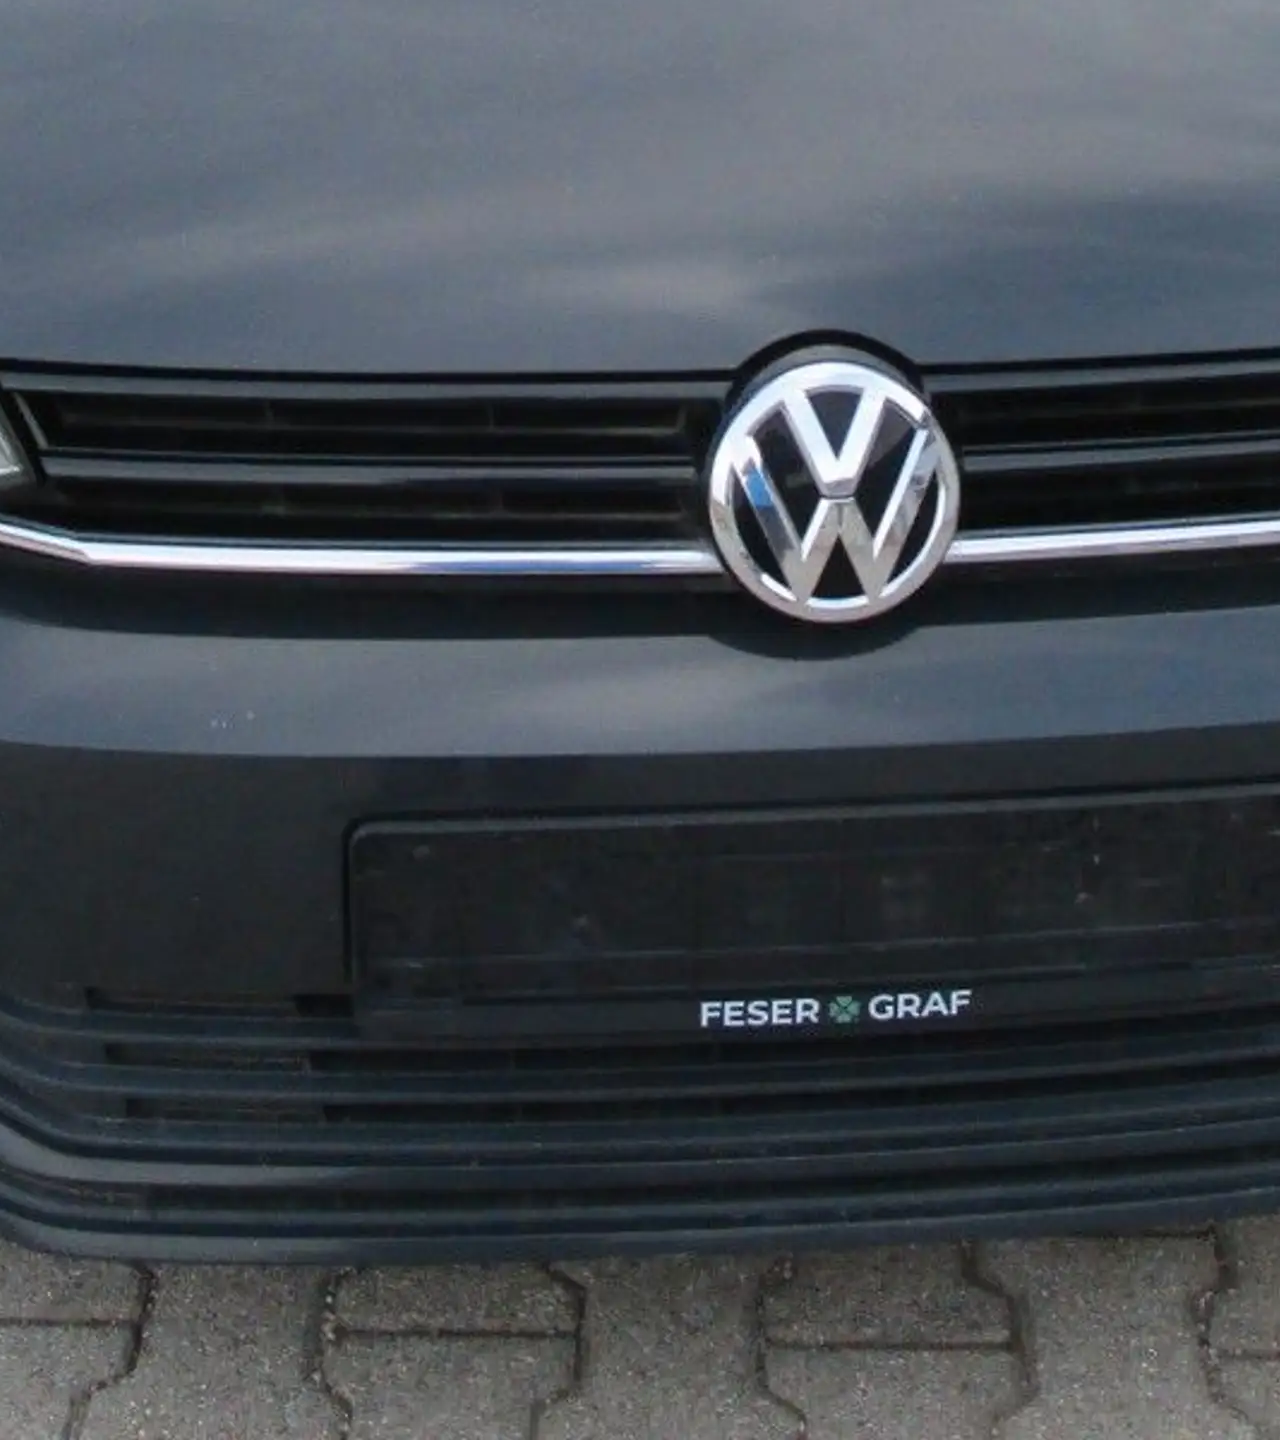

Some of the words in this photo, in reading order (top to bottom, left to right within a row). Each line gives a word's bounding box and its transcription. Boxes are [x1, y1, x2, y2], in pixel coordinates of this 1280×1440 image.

[716, 368, 954, 617] VW
[699, 997, 820, 1028] FESER
[868, 988, 973, 1021] GRAF
